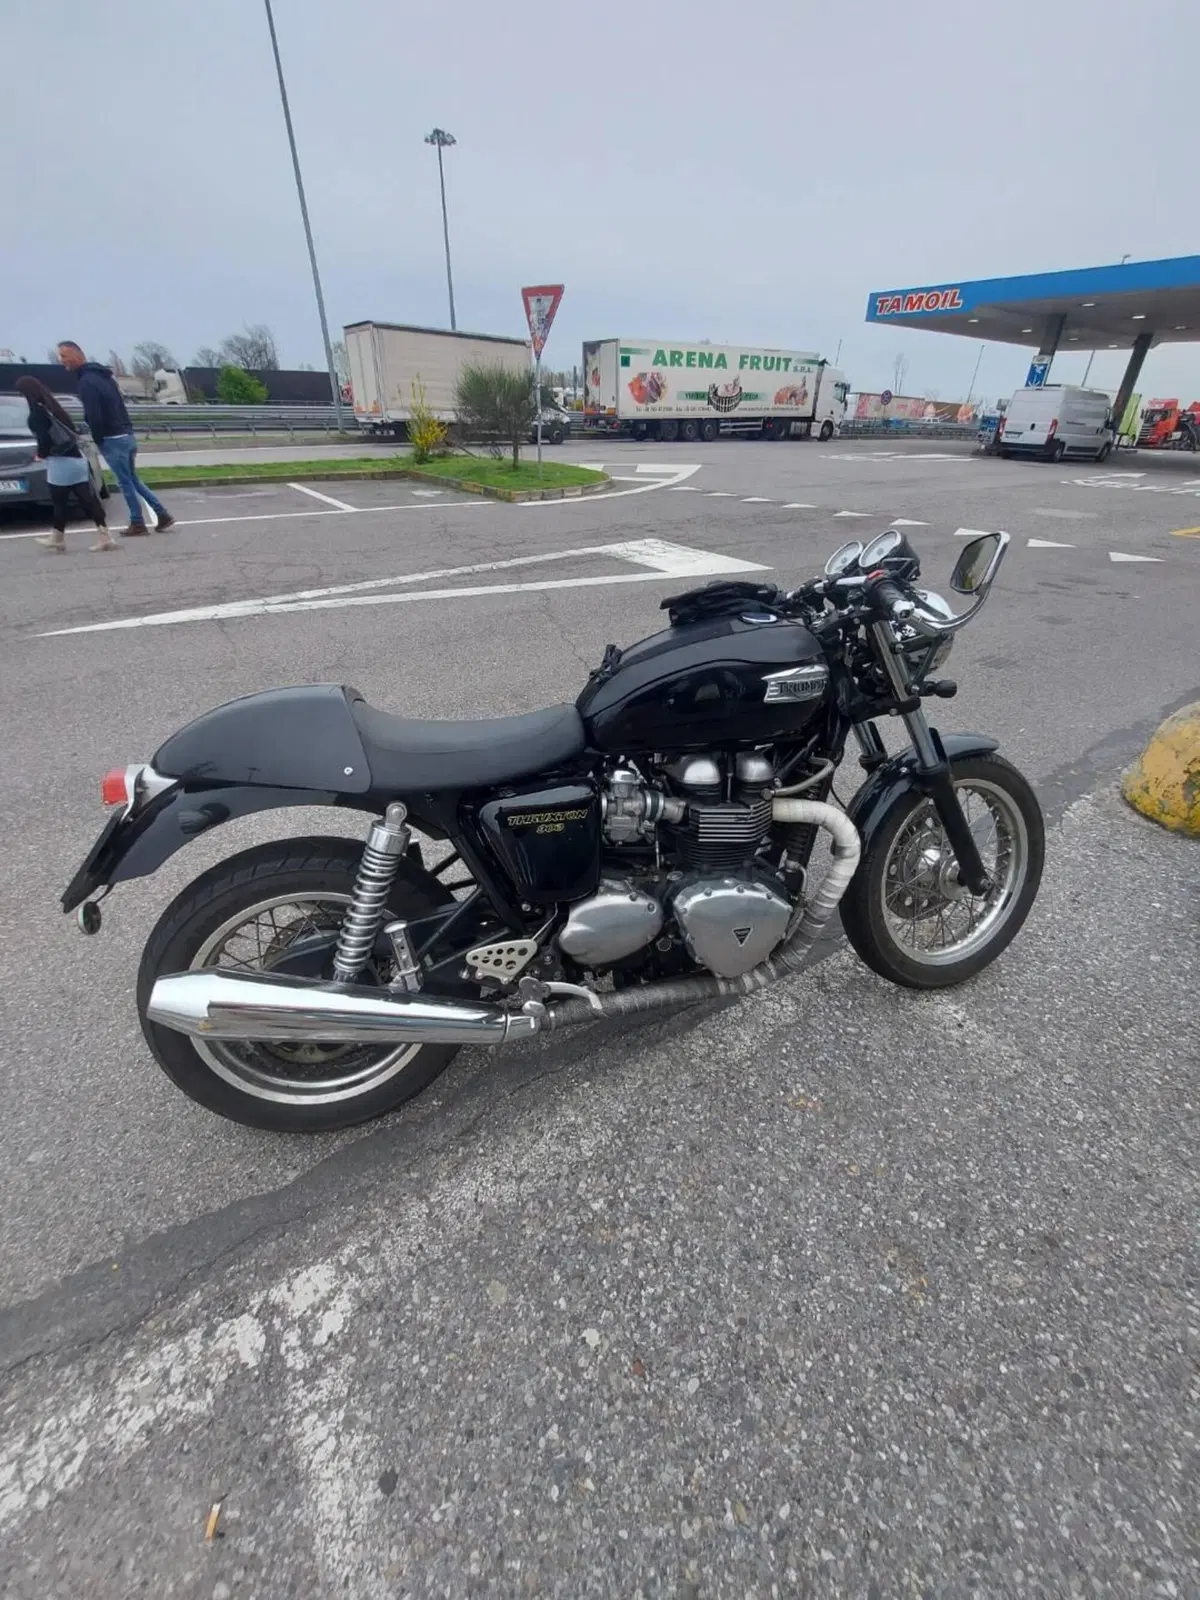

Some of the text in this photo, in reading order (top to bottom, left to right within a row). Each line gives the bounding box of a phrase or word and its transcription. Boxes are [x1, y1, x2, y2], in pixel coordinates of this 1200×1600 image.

[876, 288, 963, 315] TAMOIL
[652, 349, 728, 369] ARENA
[738, 354, 793, 372] FRUIT
[507, 809, 588, 826] THRUXTON
